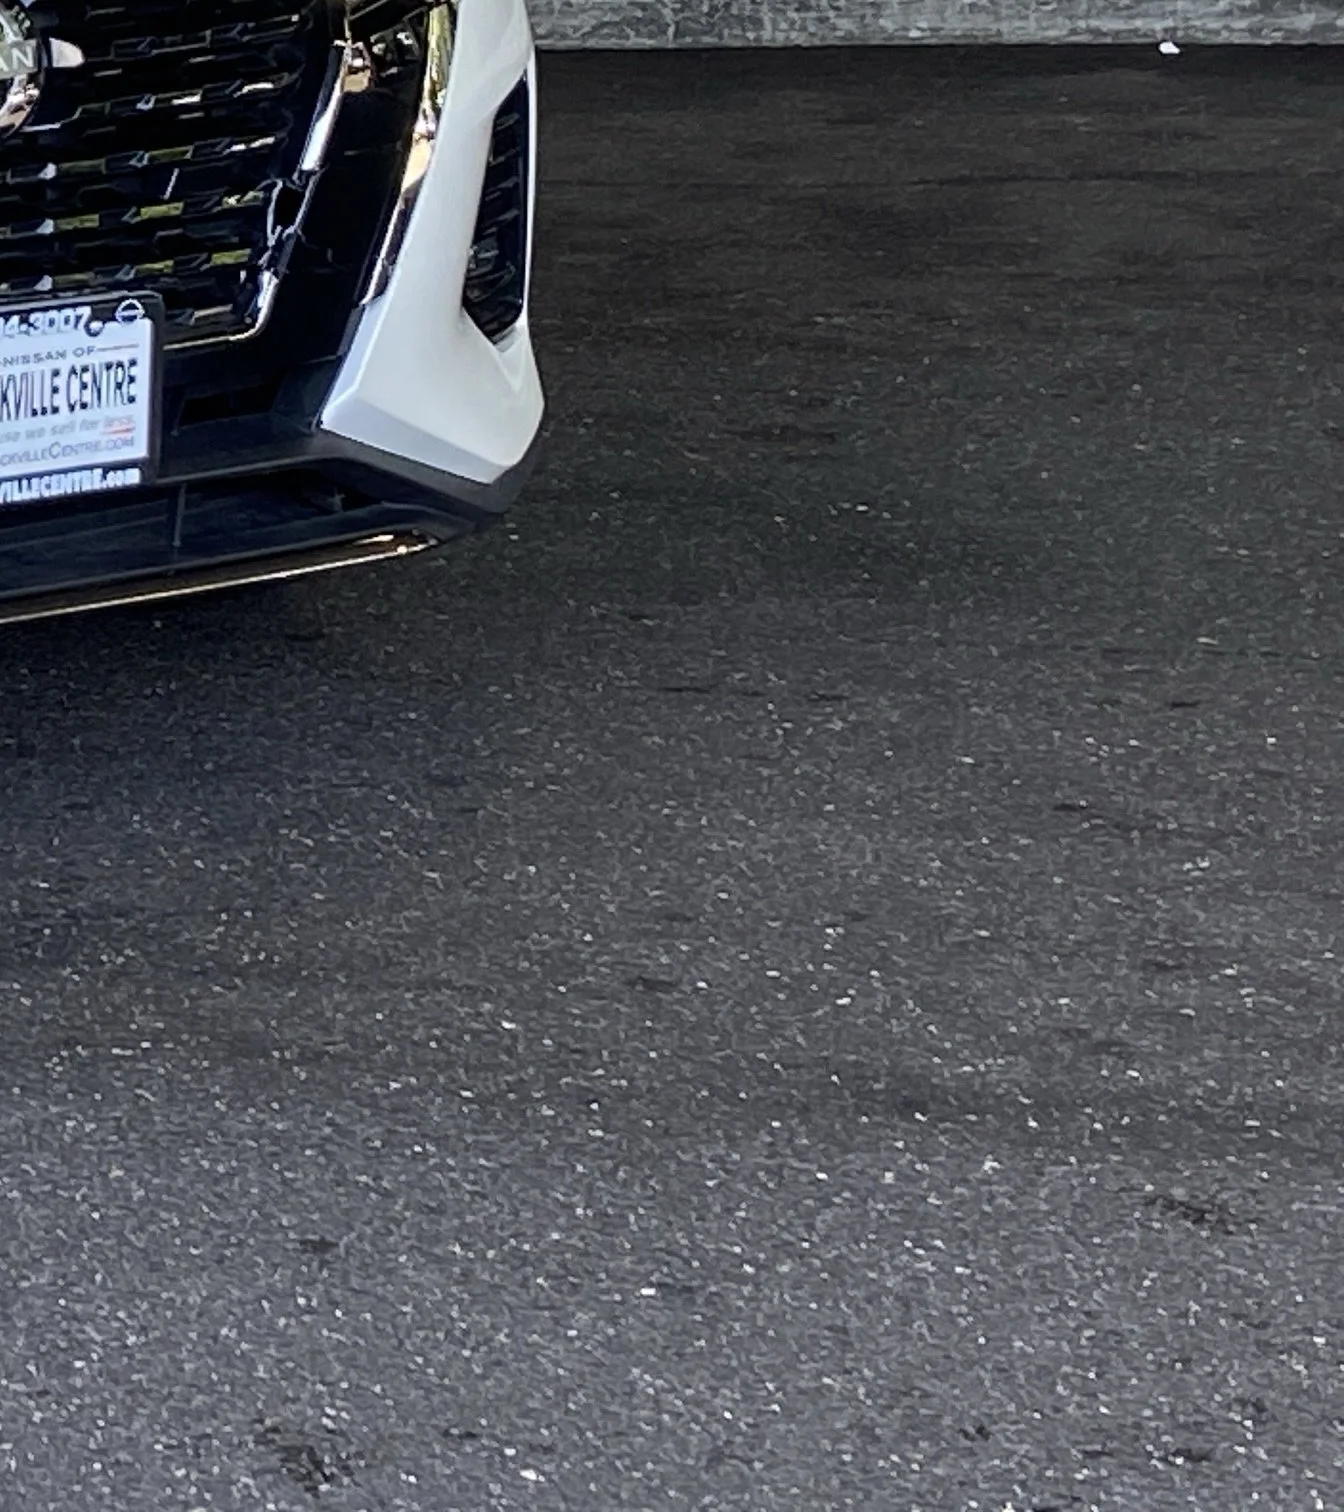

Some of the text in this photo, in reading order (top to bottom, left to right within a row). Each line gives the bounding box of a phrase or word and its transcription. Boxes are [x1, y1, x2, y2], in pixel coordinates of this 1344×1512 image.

[2, 345, 97, 367] NISSAN OF
[65, 359, 139, 414] CENTRE
[25, 427, 47, 440] we
